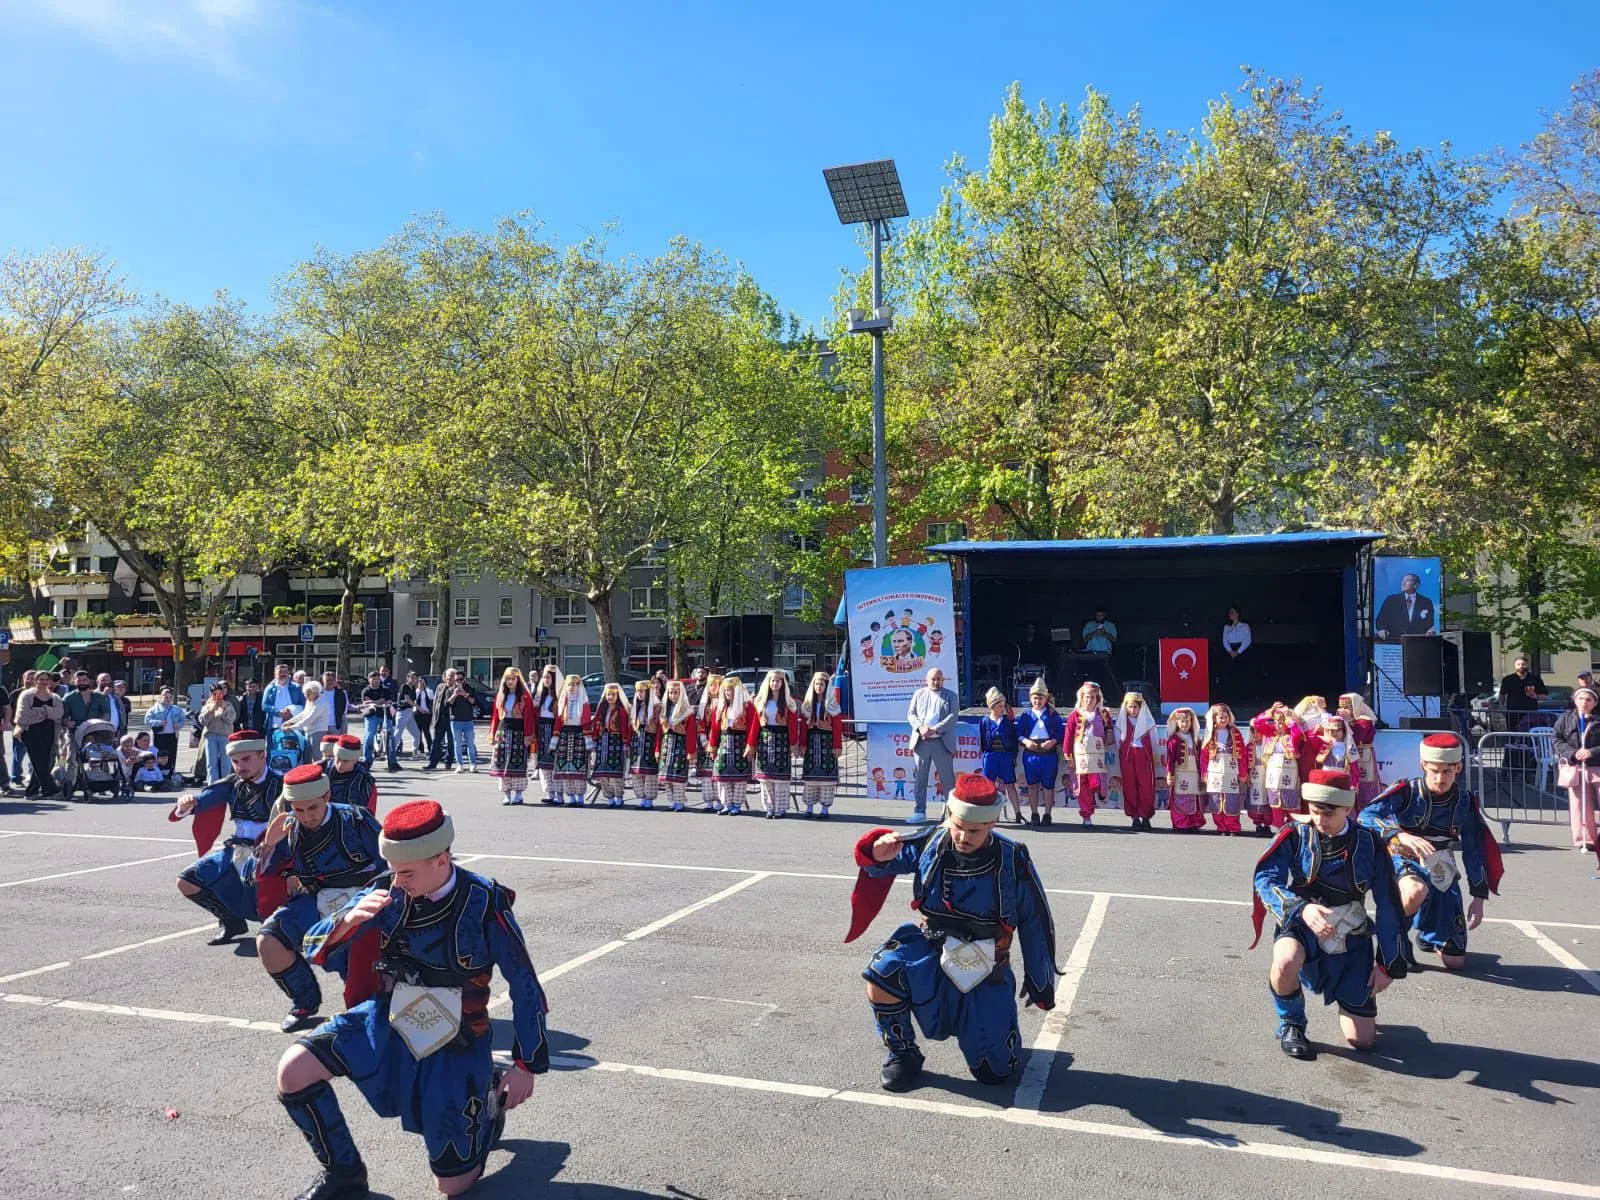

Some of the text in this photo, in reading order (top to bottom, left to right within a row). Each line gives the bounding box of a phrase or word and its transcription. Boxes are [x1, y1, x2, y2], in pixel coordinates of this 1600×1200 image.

[909, 593, 945, 604] KINDERFEST
[882, 656, 895, 666] 23
[886, 733, 910, 746] "ÇO
